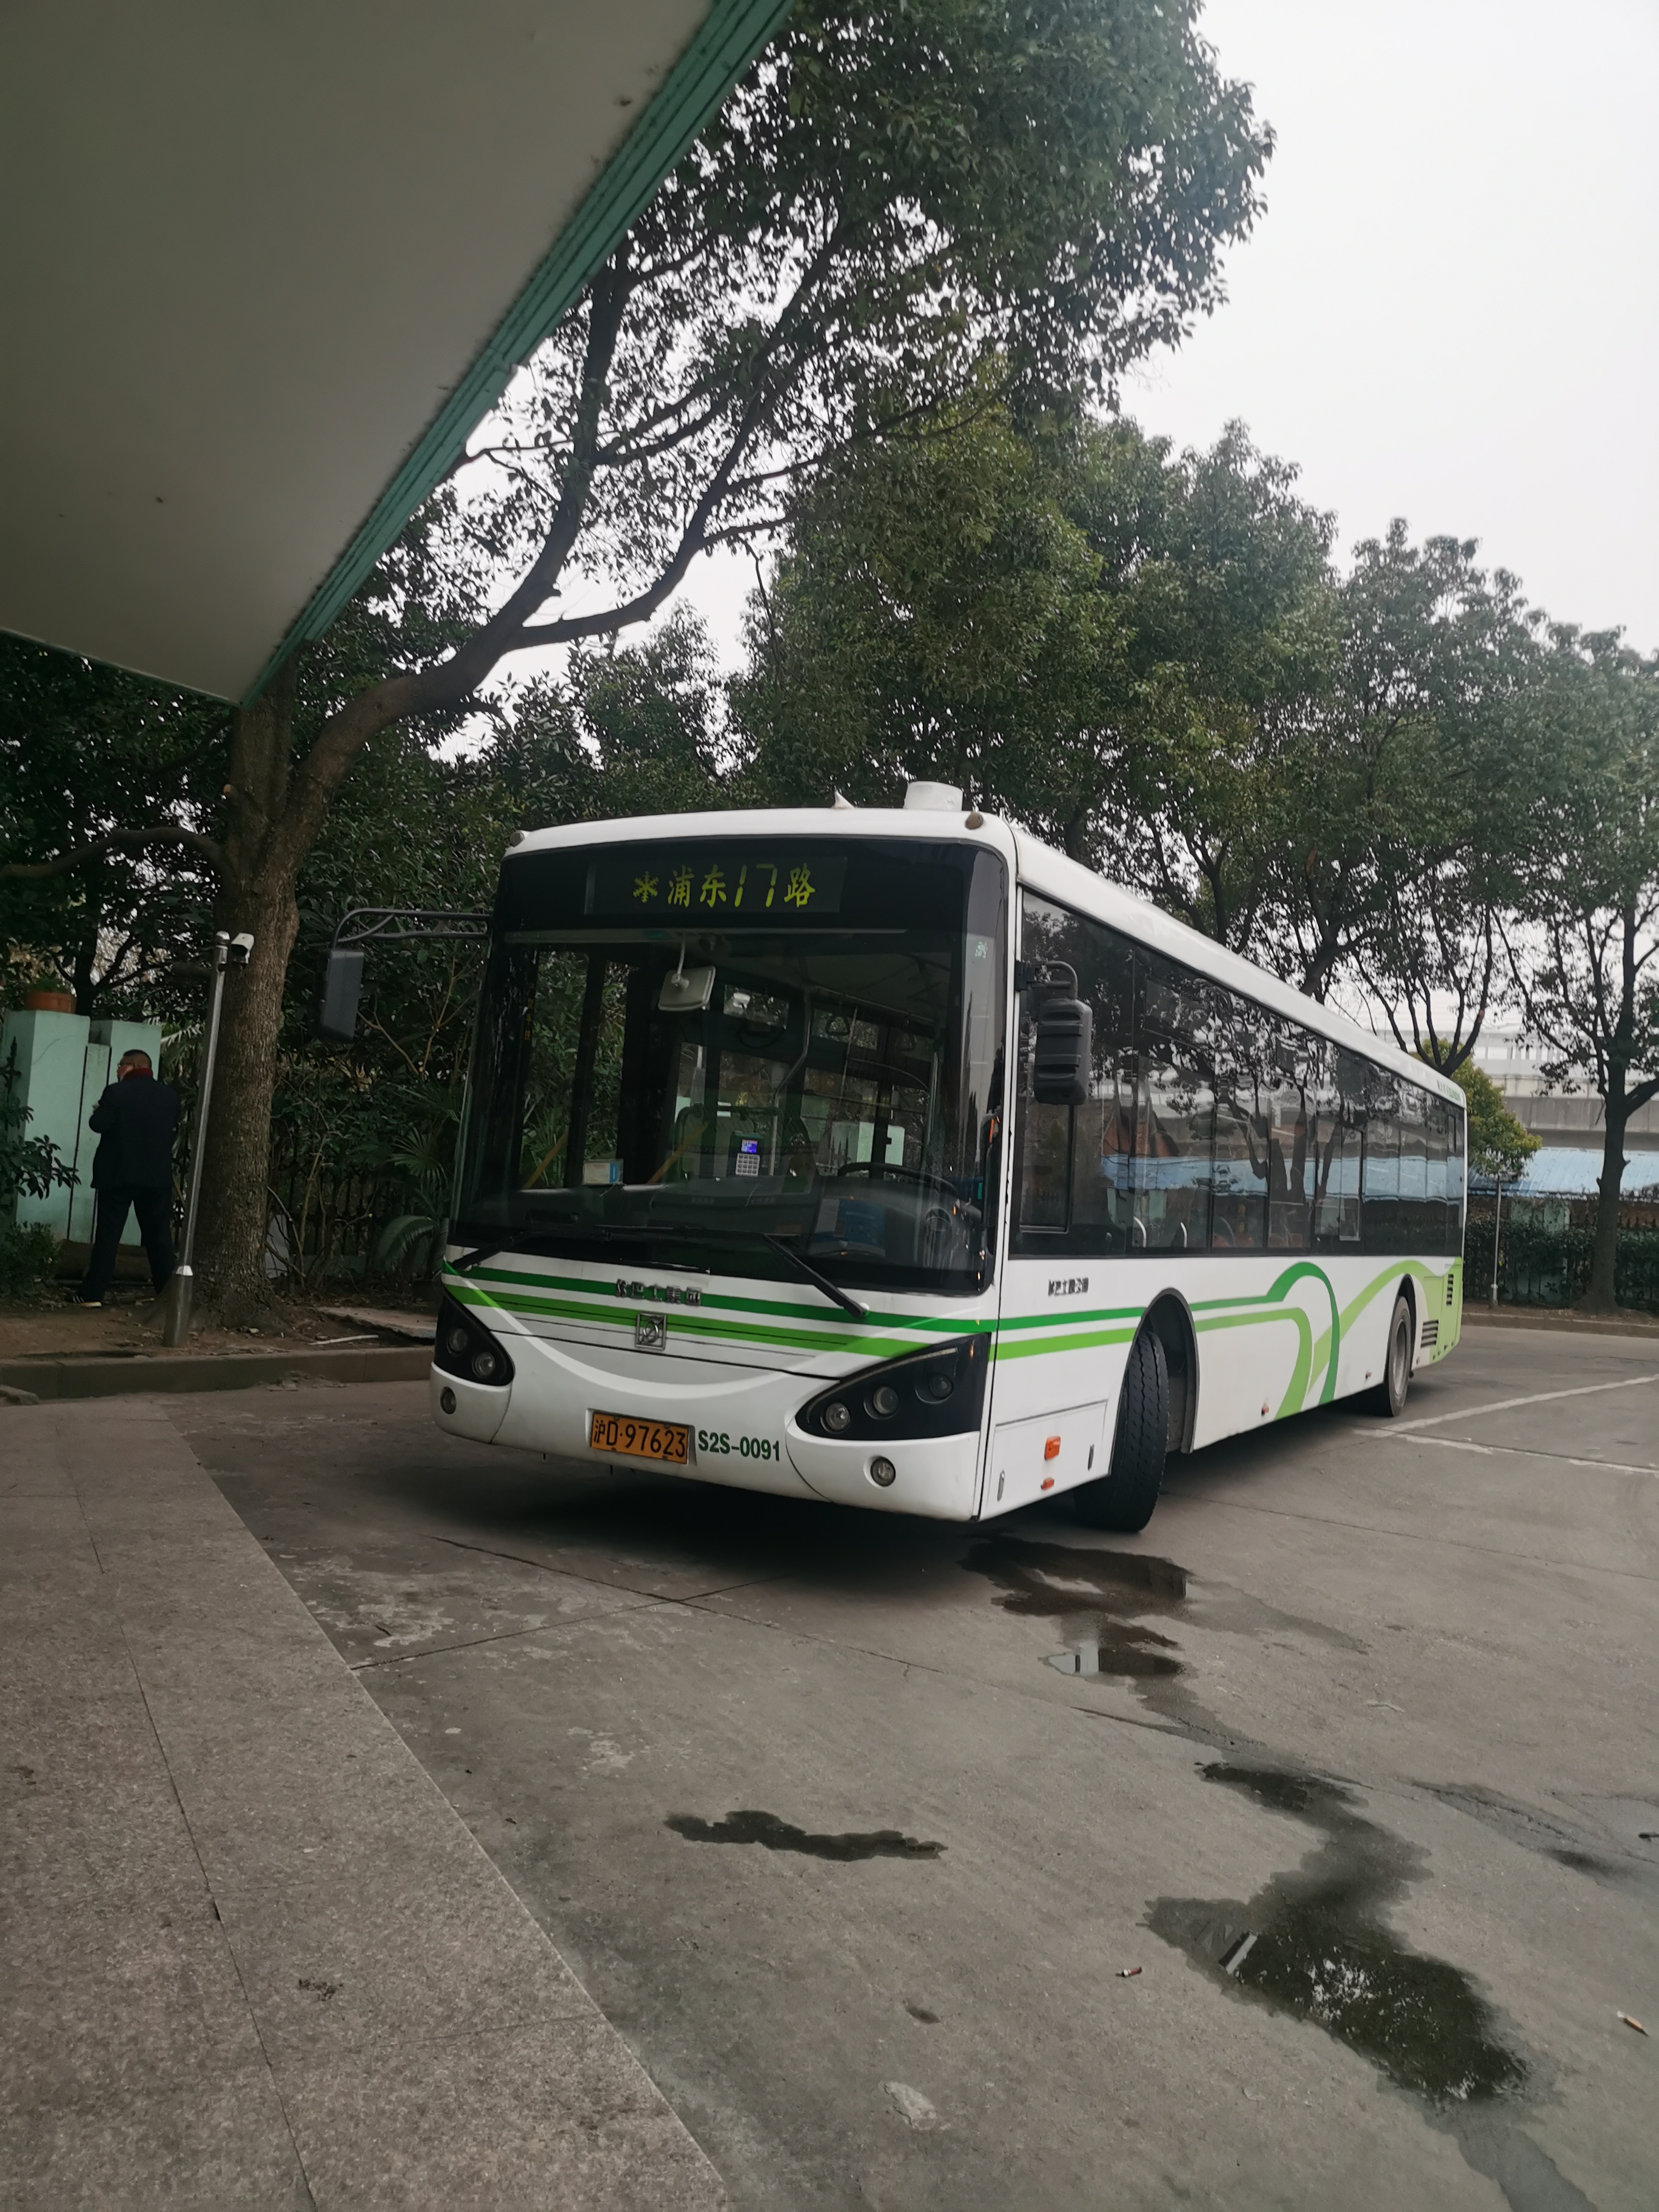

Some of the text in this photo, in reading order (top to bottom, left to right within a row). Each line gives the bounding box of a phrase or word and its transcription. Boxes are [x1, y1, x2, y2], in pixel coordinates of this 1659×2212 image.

[667, 863, 816, 908] 浦东17路
[698, 1429, 780, 1462] S2S-0091
